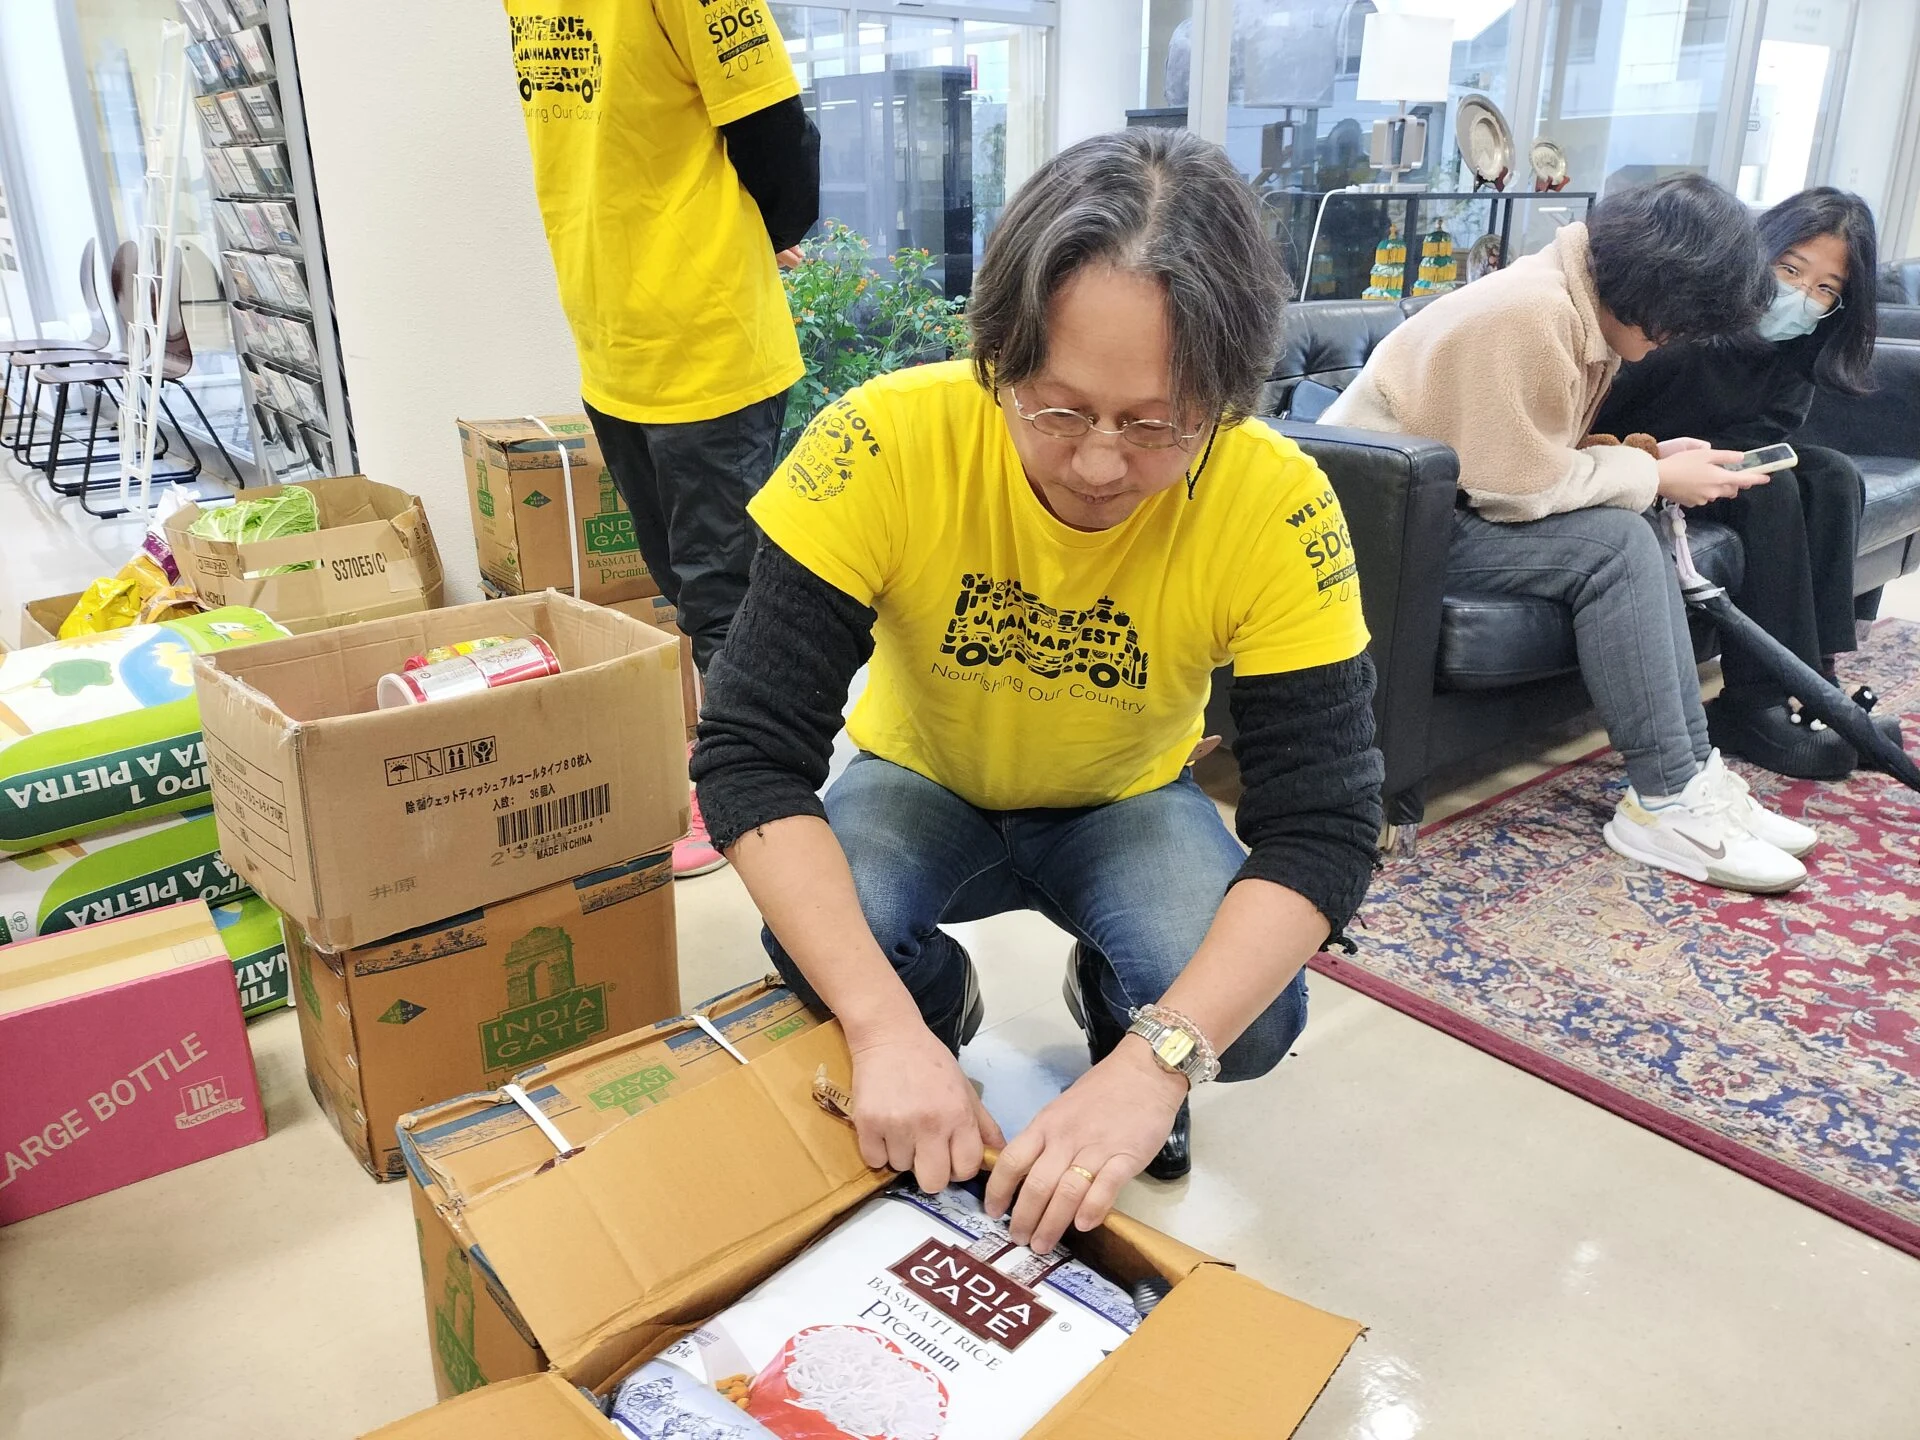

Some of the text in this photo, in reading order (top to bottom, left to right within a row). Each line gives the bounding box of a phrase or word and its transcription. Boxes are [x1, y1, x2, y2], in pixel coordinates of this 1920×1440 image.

[708, 6, 763, 44] SDGs
[722, 43, 774, 80] 2021
[844, 409, 881, 457] LOVE
[1286, 503, 1316, 528] WE
[587, 554, 638, 568] BASMATI
[931, 662, 1147, 715] Nourishing Our Country
[4, 760, 133, 809] PIETRA
[536, 844, 560, 860] MADE
[560, 841, 570, 853] IN
[569, 833, 593, 850] CHINA
[492, 997, 597, 1042] INDIA
[497, 1016, 596, 1058] GATE
[88, 1032, 208, 1122] BOTTLE
[599, 1073, 669, 1104] INDIA
[179, 1100, 238, 1127] McCormick
[909, 1264, 1019, 1339] GATE
[922, 1248, 1033, 1326] INDIA
[857, 1299, 960, 1373] Premium
[866, 1276, 1003, 1371] BASMATI RICE
